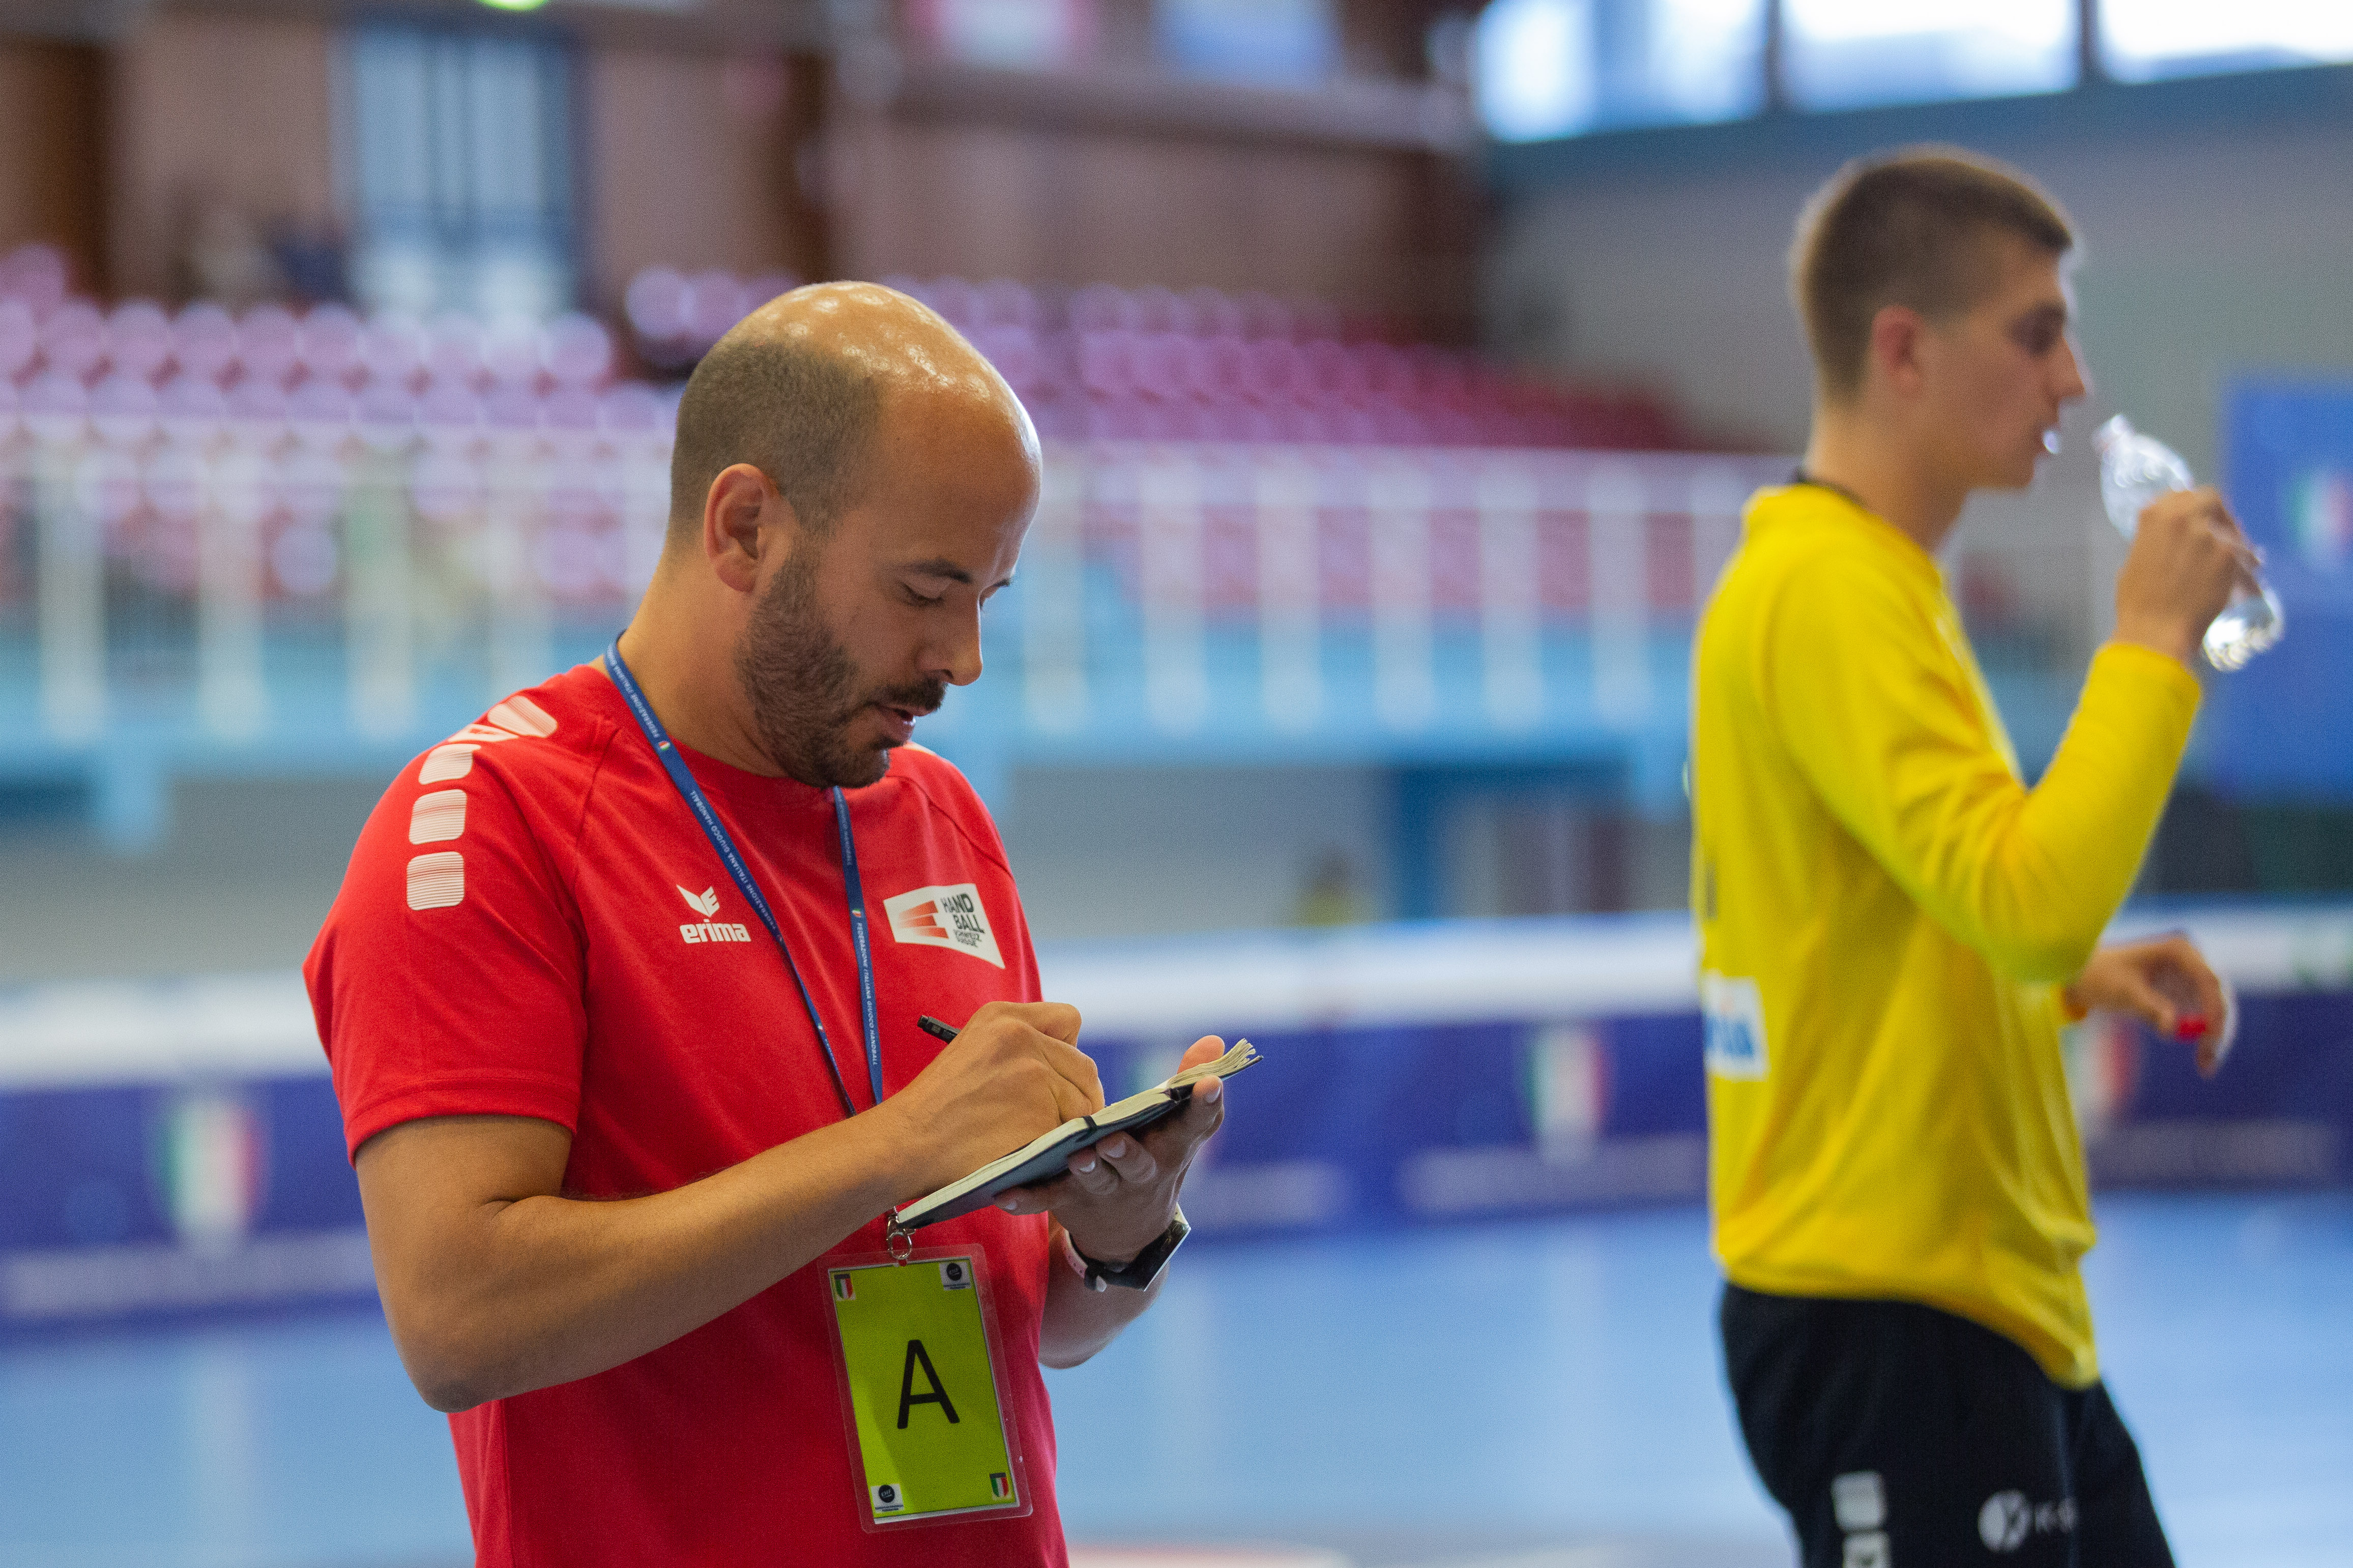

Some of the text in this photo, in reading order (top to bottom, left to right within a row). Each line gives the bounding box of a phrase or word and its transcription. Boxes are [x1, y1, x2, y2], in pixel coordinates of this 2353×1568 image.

[690, 789, 713, 825] HANDBALL
[711, 825, 731, 853] GIUOCO
[728, 852, 748, 884] ITALIANA
[940, 894, 974, 913] HAND
[679, 919, 751, 944] erima
[953, 914, 985, 934] BALL
[856, 922, 868, 967] FEDERAZIONE
[866, 1000, 875, 1029] GIUOCO
[869, 1029, 878, 1066] HANDBALL
[897, 1339, 961, 1430] A
